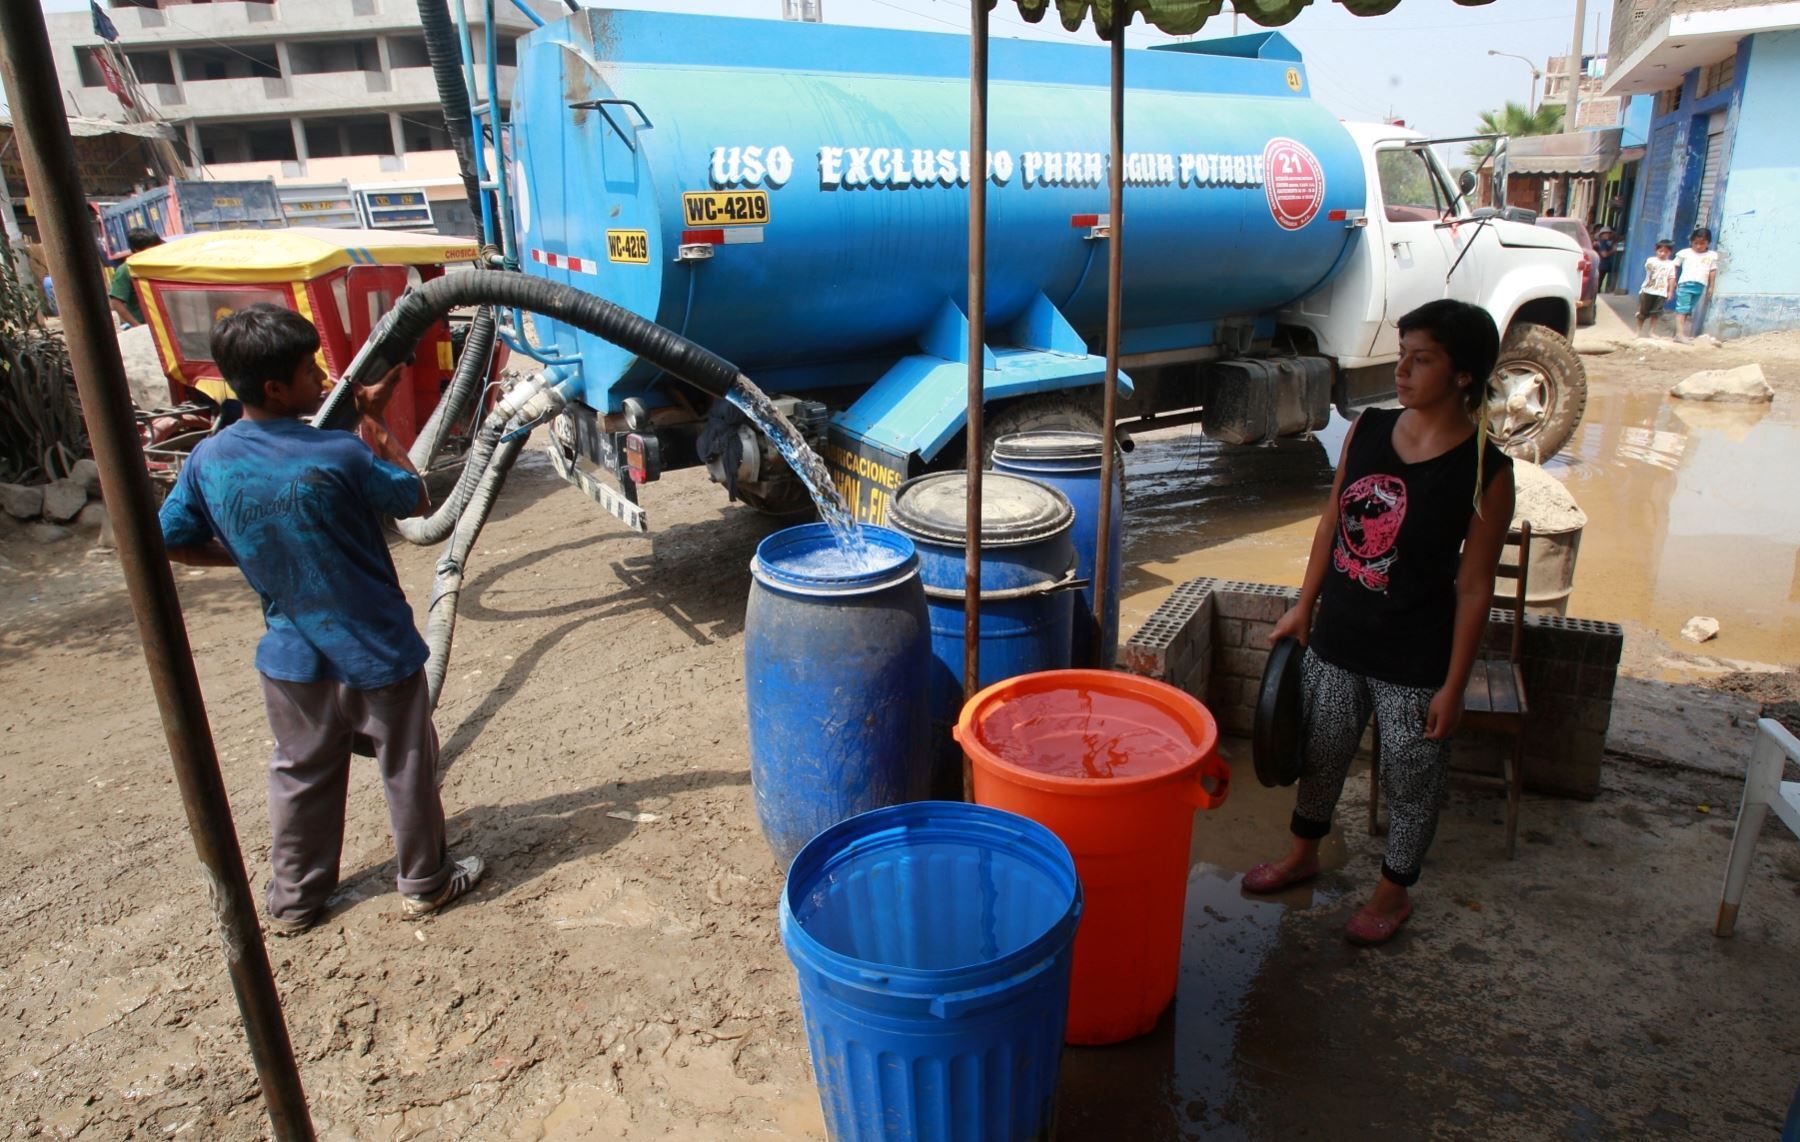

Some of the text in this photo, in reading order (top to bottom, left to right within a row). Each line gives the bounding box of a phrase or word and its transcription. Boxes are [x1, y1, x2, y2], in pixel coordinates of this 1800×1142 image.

[1287, 71, 1300, 87] 21
[710, 145, 794, 188] USO
[817, 146, 1014, 189] EXCLUSIO
[1021, 151, 1103, 187] PARA
[1108, 152, 1175, 185] GUA
[1278, 153, 1303, 174] 21
[686, 195, 766, 222] WC-4219
[444, 248, 477, 260] CHOSICA
[608, 234, 647, 259] WC-4219
